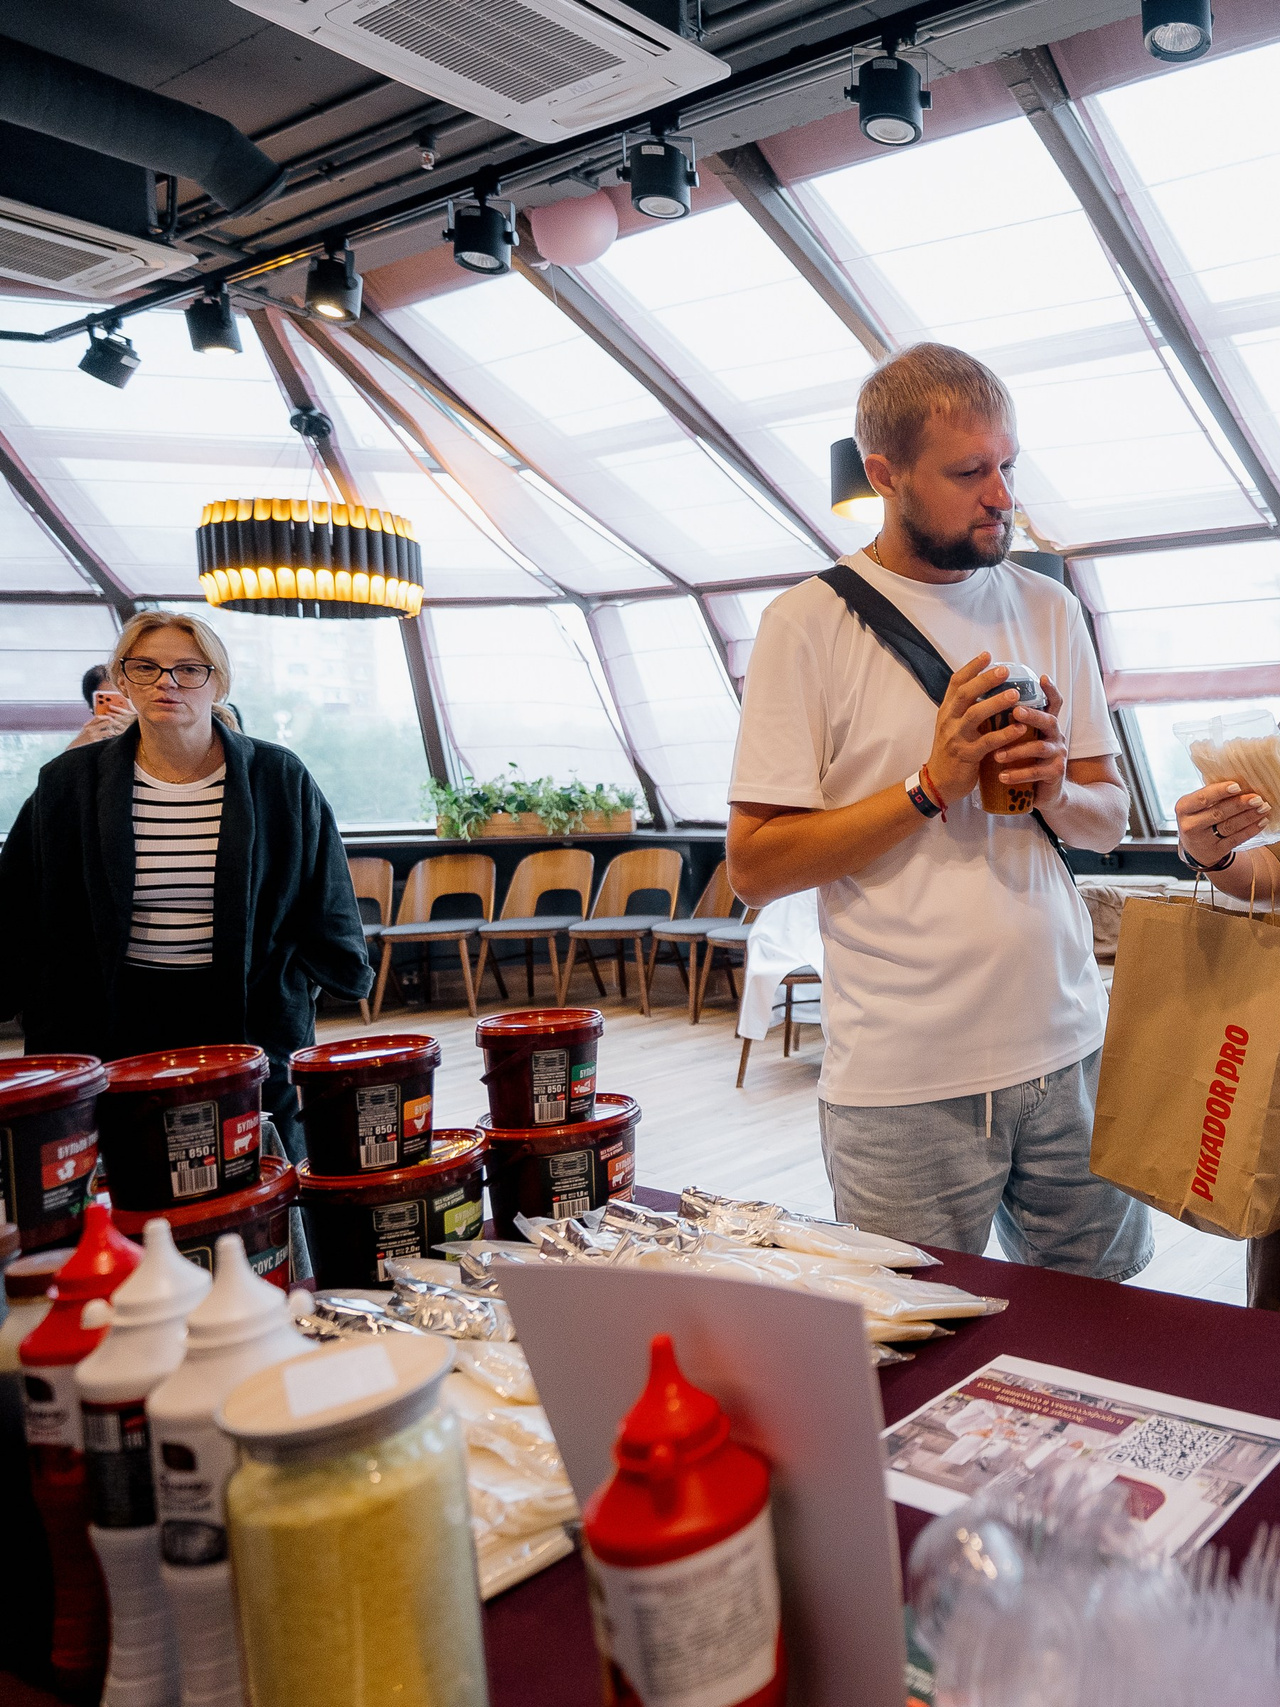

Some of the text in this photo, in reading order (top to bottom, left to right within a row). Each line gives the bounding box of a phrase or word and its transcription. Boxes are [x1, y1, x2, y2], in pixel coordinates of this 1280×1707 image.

[547, 1085, 561, 1093] 850
[1191, 1024, 1249, 1202] PIKADOR PRO
[375, 1124, 392, 1135] 850
[188, 1145, 209, 1159] 850
